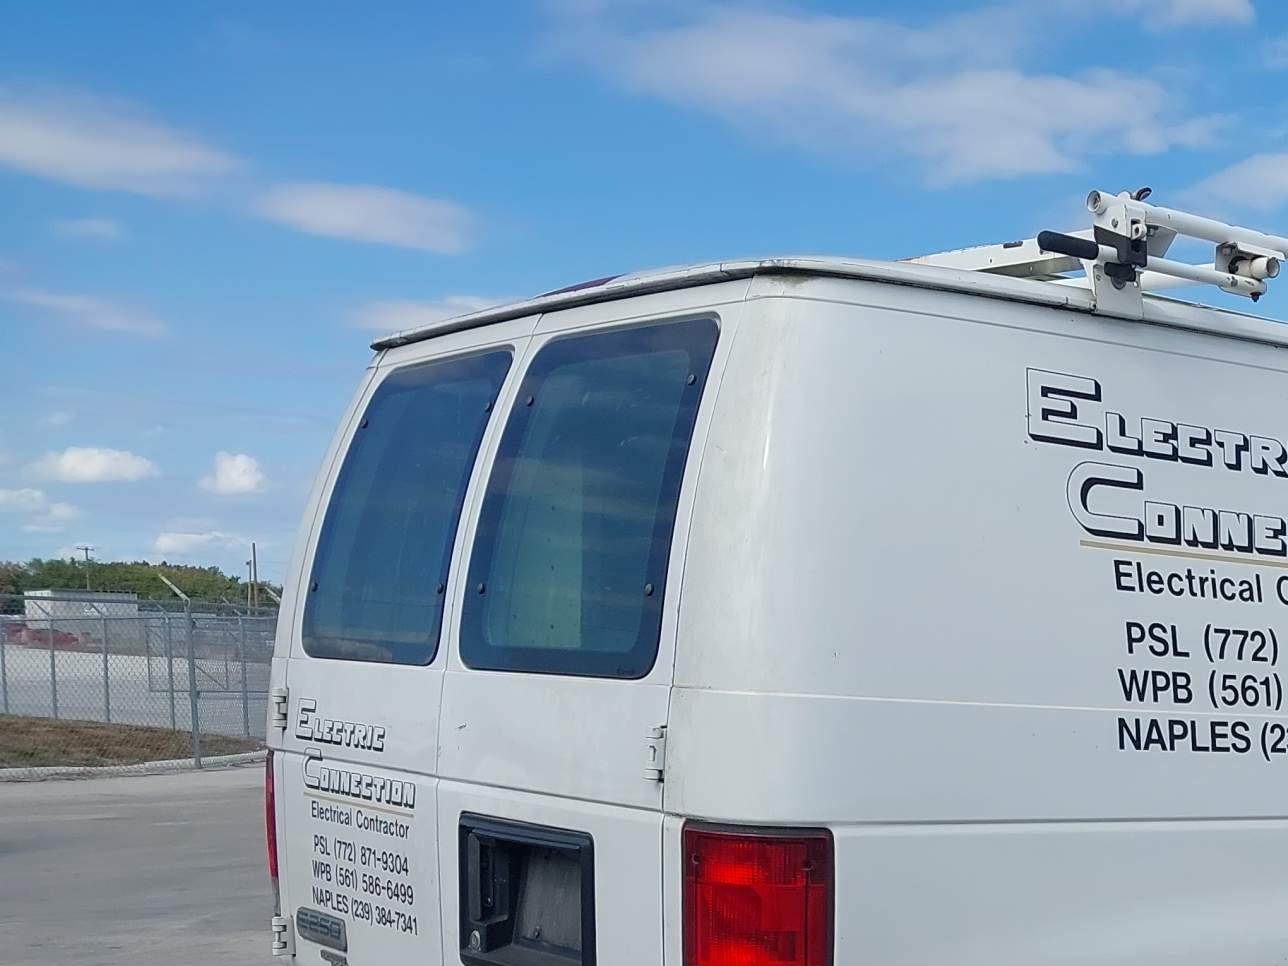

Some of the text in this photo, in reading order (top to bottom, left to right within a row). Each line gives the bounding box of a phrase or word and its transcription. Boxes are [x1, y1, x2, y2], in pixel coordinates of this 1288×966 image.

[1113, 559, 1263, 603] Electrical
[1125, 621, 1190, 658] PSL
[1203, 624, 1279, 665] (772)
[1118, 668, 1193, 704] WPB
[1208, 670, 1283, 711] (561)
[295, 697, 386, 753] ELECTRIC
[1117, 718, 1251, 754] NAPLES
[301, 747, 417, 809] CONNECTION
[311, 800, 410, 839] Electrical Contractor
[314, 834, 409, 877] PSL (772) 871-9304
[312, 859, 414, 905] WPB (561) 586-6499
[312, 885, 418, 937] NAPLES (239) 384-7341
